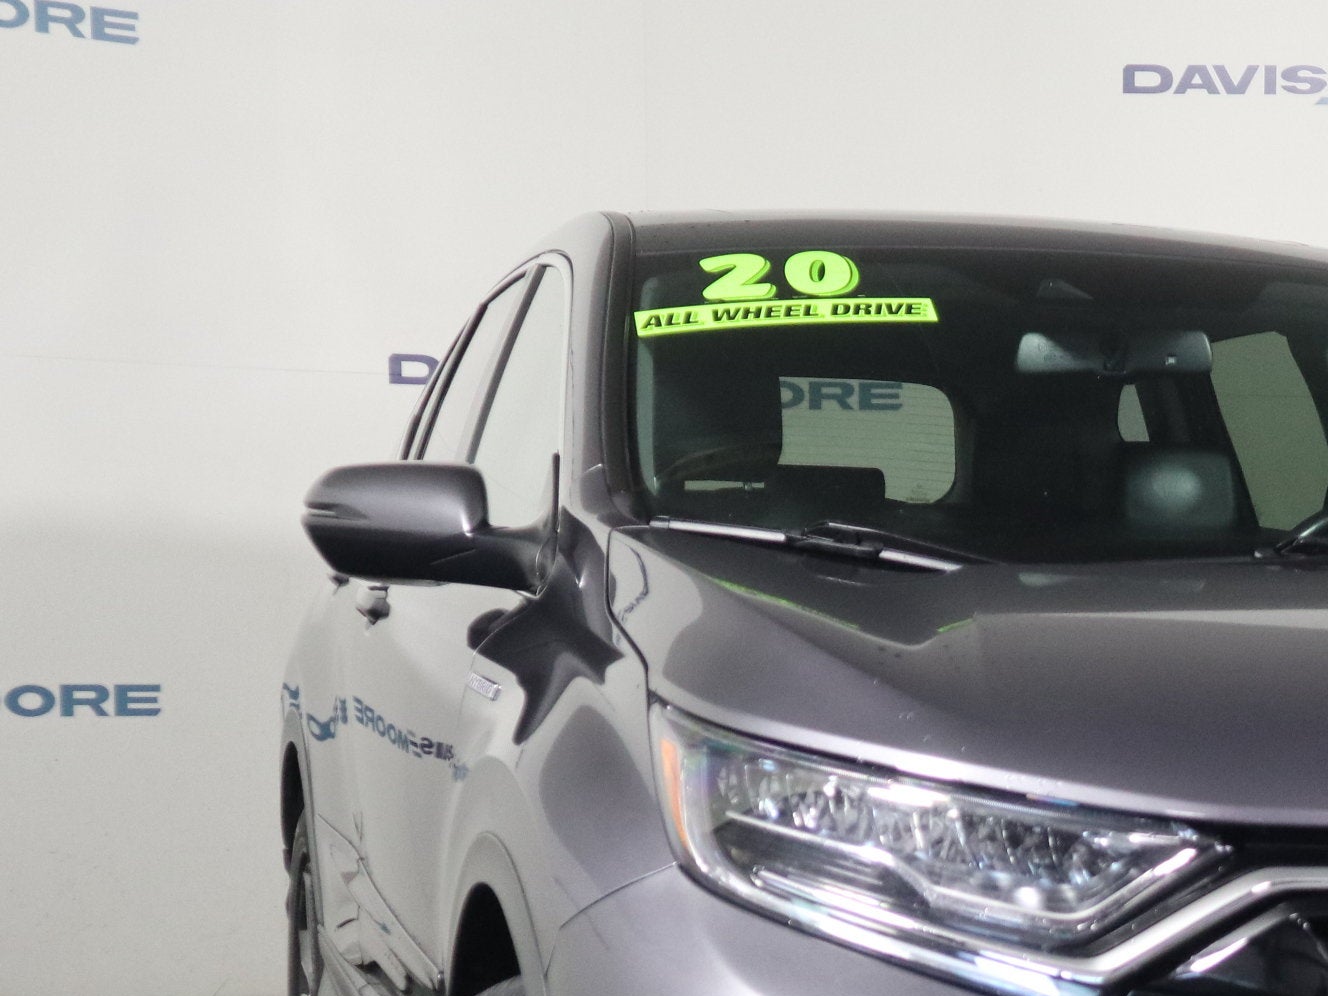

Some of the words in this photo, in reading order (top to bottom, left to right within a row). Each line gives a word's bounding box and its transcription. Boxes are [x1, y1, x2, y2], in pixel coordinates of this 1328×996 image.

[1122, 64, 1327, 95] DAVIS
[700, 251, 861, 300] 20
[640, 310, 699, 330] ALL
[711, 302, 819, 322] WHEEL
[830, 301, 922, 316] DRIVE
[4, 684, 161, 717] ORE
